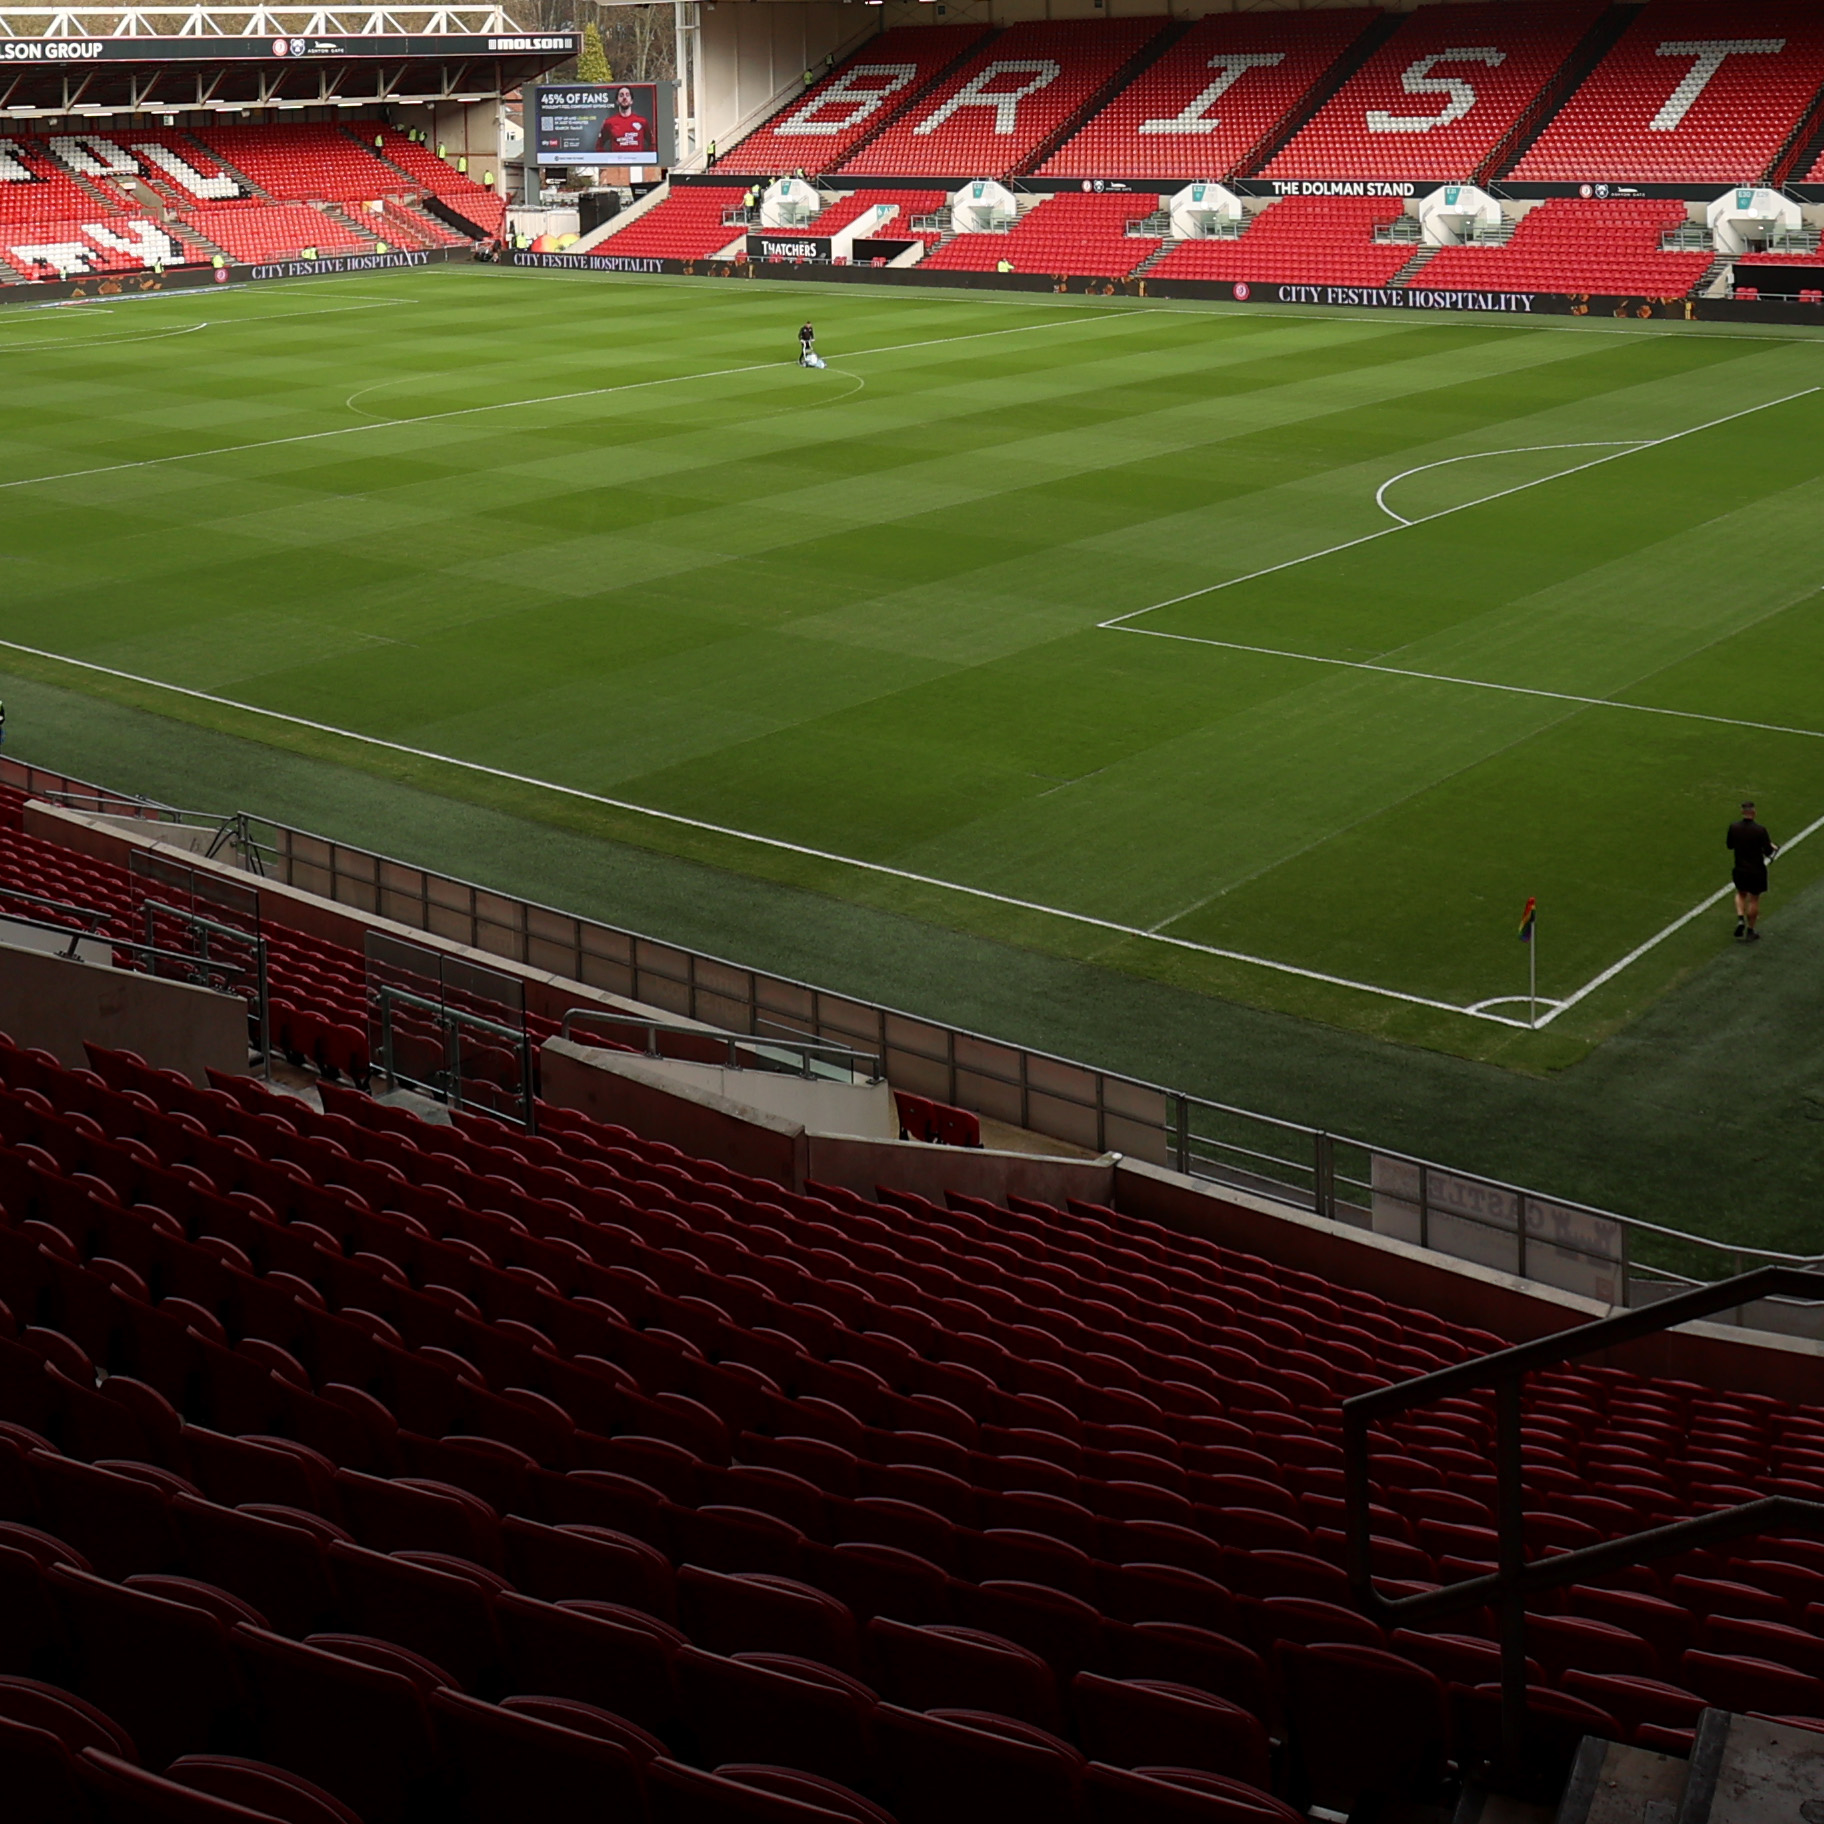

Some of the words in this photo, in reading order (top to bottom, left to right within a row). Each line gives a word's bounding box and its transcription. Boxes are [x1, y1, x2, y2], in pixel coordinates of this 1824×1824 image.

[45, 43, 103, 58] GROUP
[497, 38, 564, 50] MOLSON
[541, 94, 565, 104] 45%
[566, 93, 581, 104] OF
[582, 93, 609, 104] FANS
[1272, 182, 1299, 194] THE
[1303, 182, 1363, 195] DOLMAN
[1367, 183, 1415, 196] STAND
[761, 241, 817, 257] THATCHERS
[252, 266, 290, 279] CITY
[289, 259, 344, 276] FESTIVE
[347, 251, 430, 271] HOSPITALITY
[514, 253, 543, 266] CITY
[543, 256, 588, 269] FESTIVE
[590, 257, 664, 273] HOSPITALITY
[1279, 286, 1322, 303] CITY
[1327, 288, 1404, 307] FESTIVE
[1408, 291, 1535, 312] HOSPITALITY
